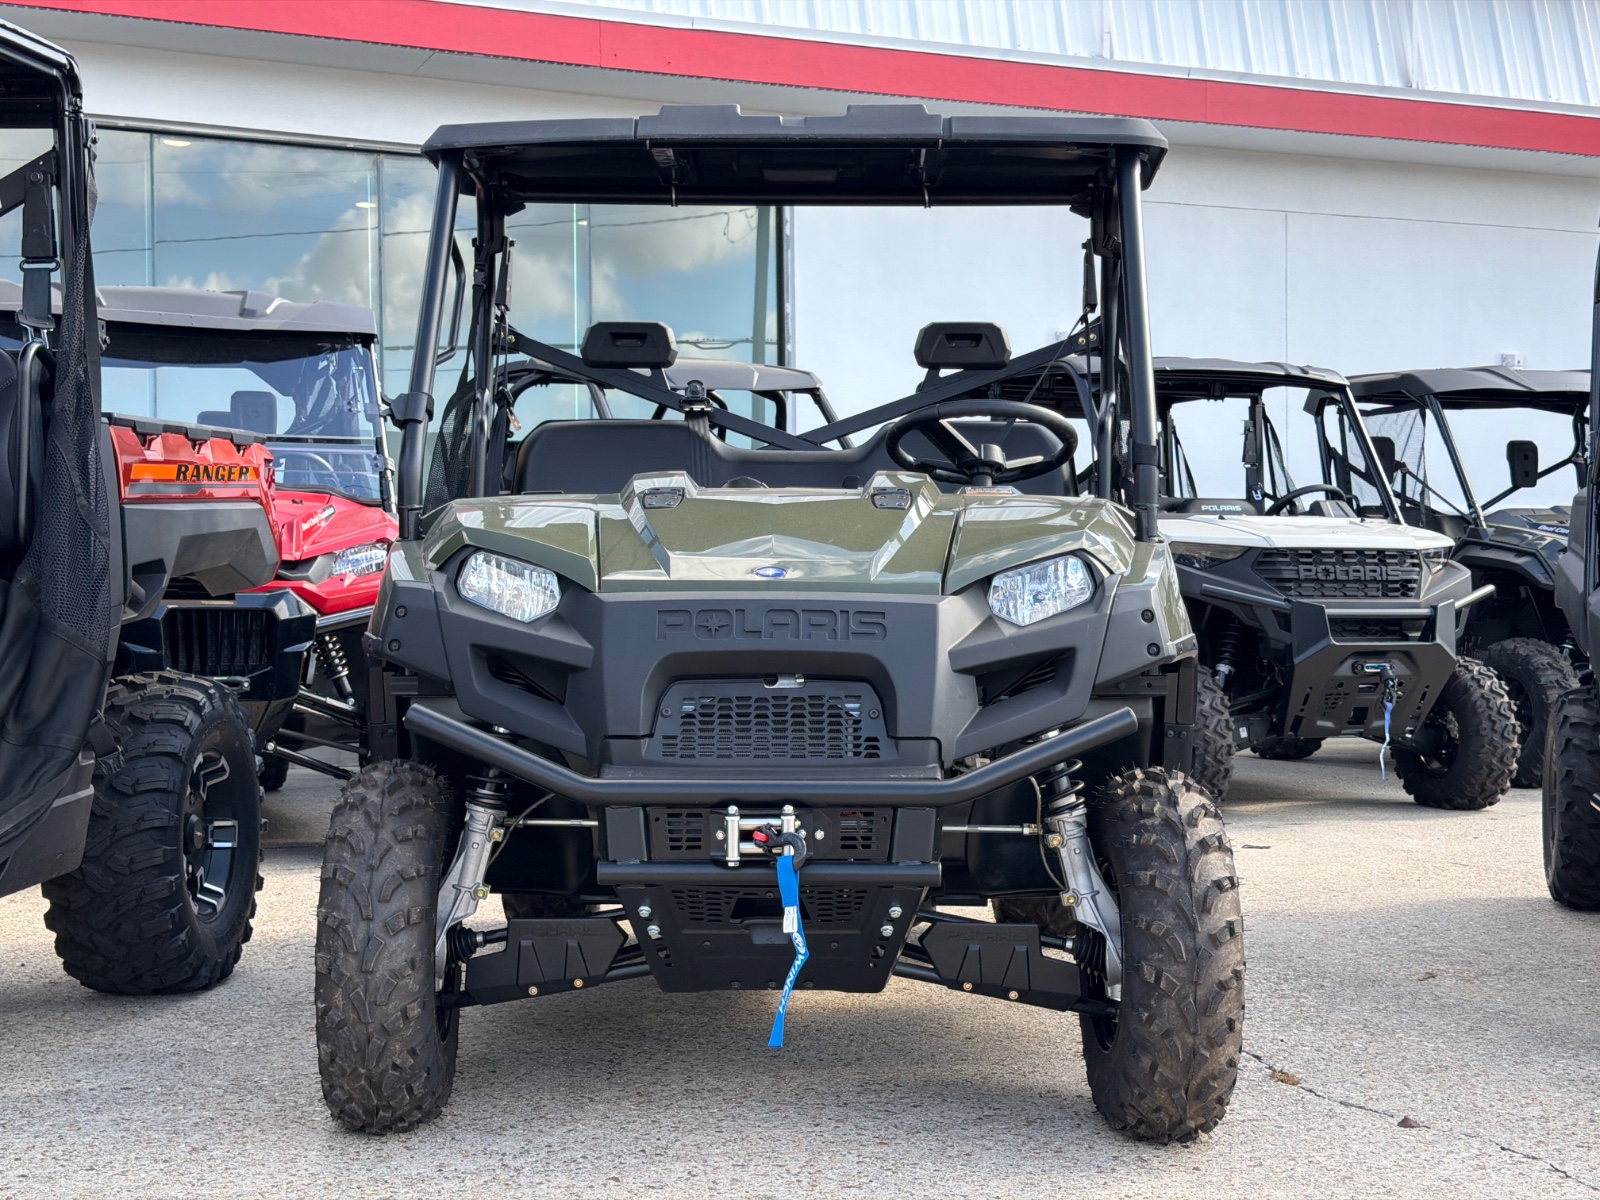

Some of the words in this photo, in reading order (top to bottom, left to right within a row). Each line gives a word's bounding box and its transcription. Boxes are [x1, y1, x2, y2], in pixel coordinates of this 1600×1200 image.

[176, 464, 250, 482] RANGER
[1299, 565, 1401, 580] POLARIS
[656, 609, 887, 641] POLARIS
[779, 954, 804, 1014] WINCH
